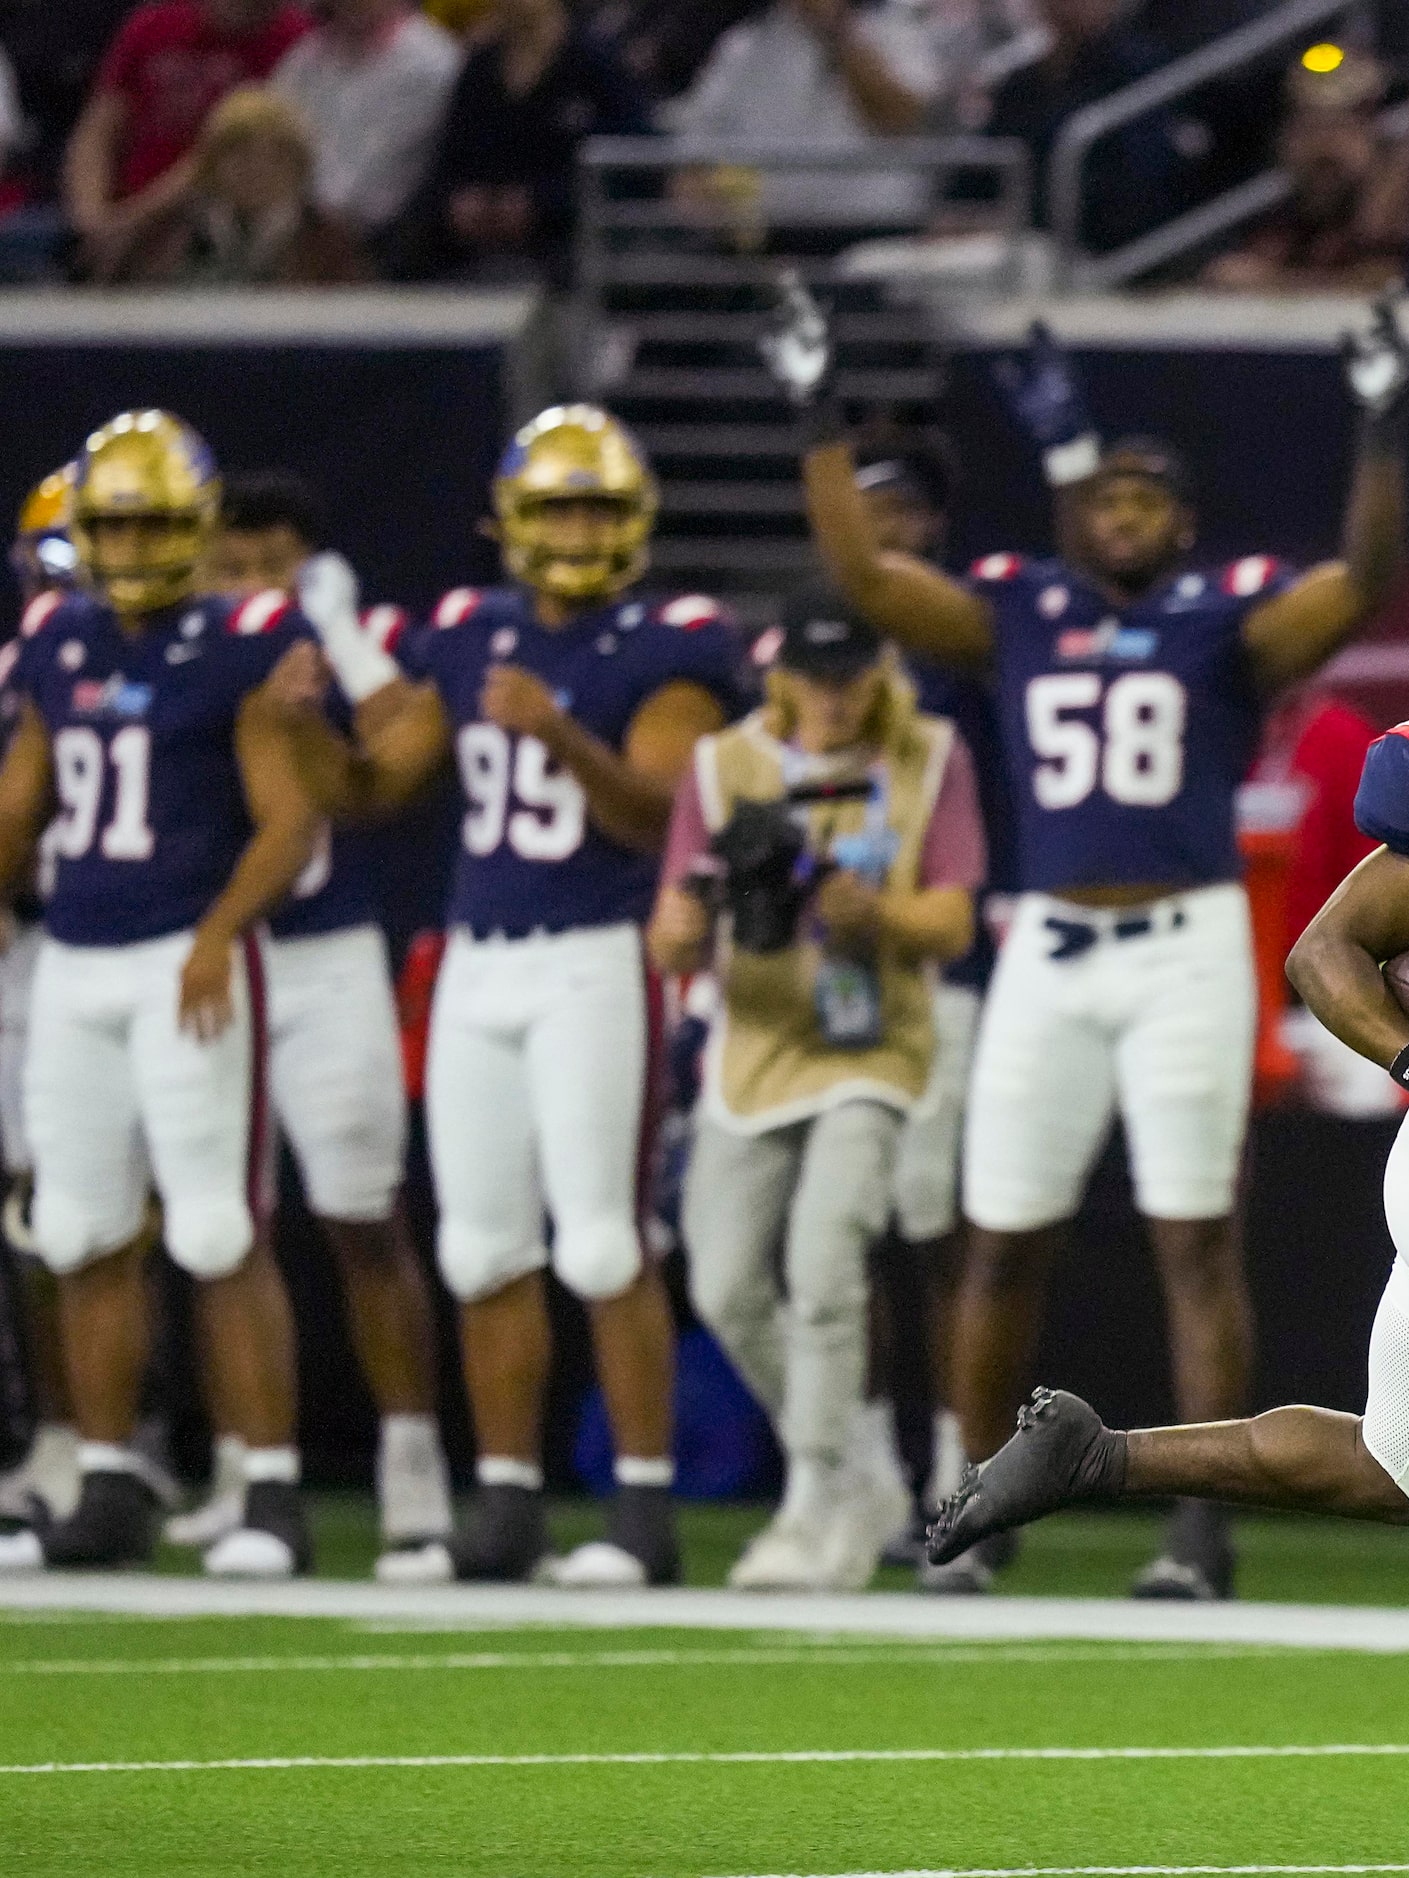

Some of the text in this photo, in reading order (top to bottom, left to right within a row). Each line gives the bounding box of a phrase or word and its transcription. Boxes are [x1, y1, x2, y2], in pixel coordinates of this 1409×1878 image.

[54, 725, 155, 861] 91
[457, 721, 587, 862] 95
[1025, 669, 1187, 811] 58
